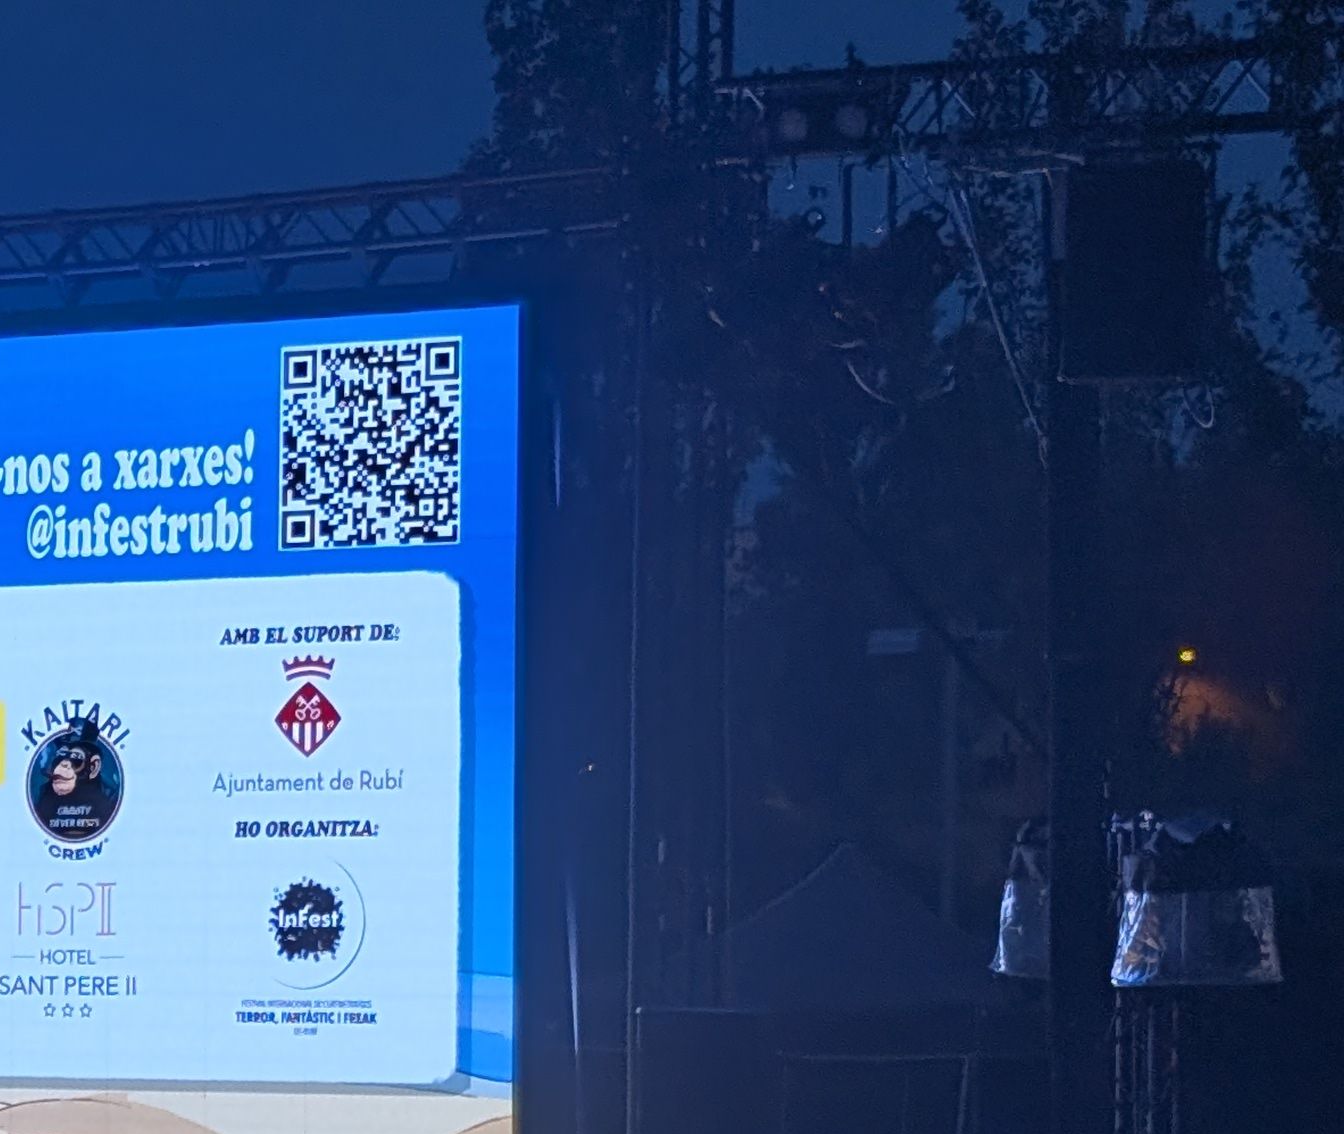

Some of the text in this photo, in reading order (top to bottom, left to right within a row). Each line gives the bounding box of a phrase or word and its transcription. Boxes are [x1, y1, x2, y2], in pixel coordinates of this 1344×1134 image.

[80, 452, 103, 492] a
[112, 428, 255, 490] xarxes!
[26, 496, 254, 560] @infestrubi
[219, 623, 401, 645] AMB EL SUPORT DE:
[212, 767, 404, 799] Ajuntament de Rubí
[234, 819, 380, 838] HO ORGANITZA:
[47, 840, 105, 862] CREW
[39, 948, 97, 966] HOTEL
[64, 975, 120, 996] PERE
